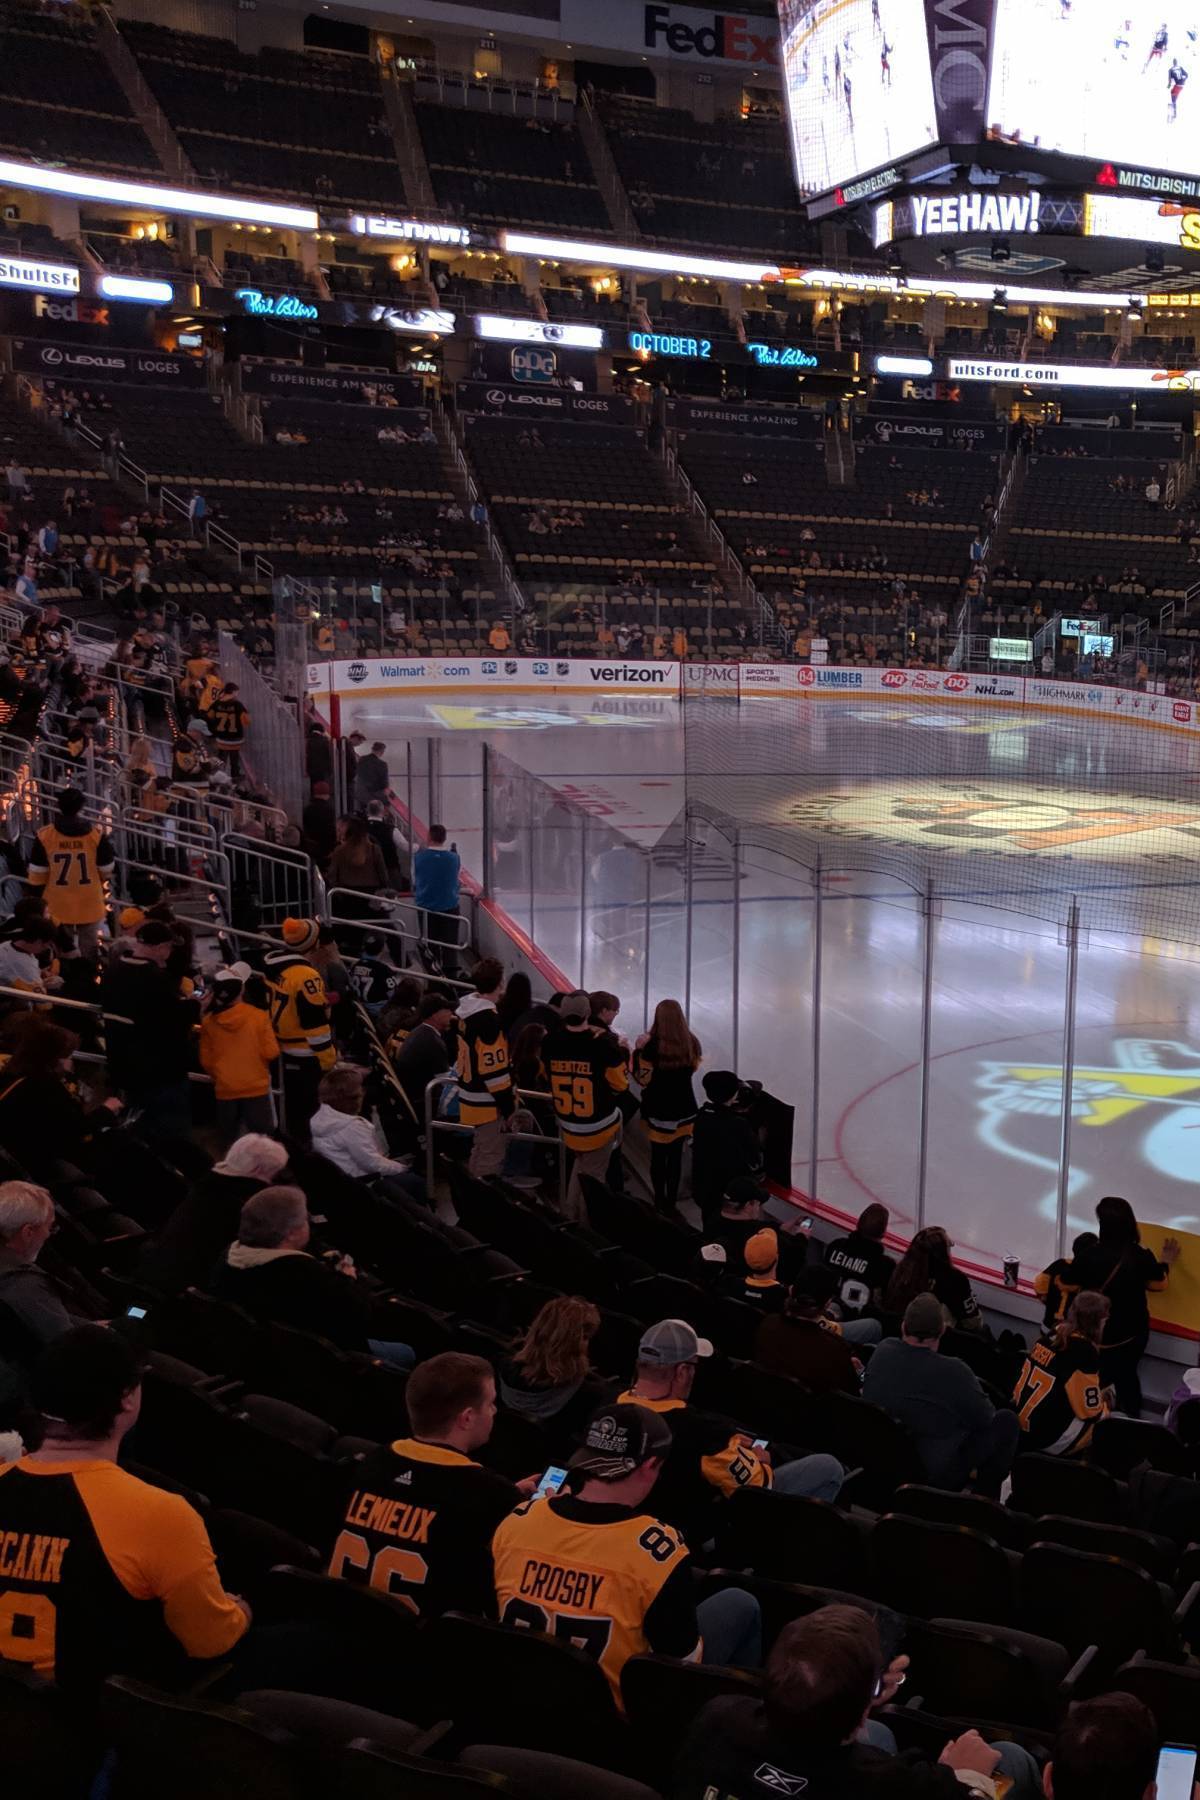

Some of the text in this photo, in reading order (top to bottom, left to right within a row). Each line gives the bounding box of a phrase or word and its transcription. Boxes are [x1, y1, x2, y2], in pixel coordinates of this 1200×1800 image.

[644, 4, 779, 65] FedEx
[870, 168, 897, 191] ELECTRIC
[1119, 170, 1196, 197] MITSUBISHI
[911, 191, 1040, 236] YEEHAW!
[34, 295, 110, 326] FedEx
[238, 289, 318, 319] Phil Collins
[632, 332, 711, 357] OCTOBER 2
[748, 343, 818, 368] Phil Collins
[65, 354, 180, 374] LEXUS LOGES
[954, 363, 1059, 381] ultsFord.com
[270, 373, 395, 393] EXPERIENCE AMAING
[902, 380, 961, 403] FedEx
[508, 393, 609, 412] LEXUS LOGES
[690, 408, 798, 426] EXPERIENCE AMAZING
[894, 425, 985, 439] LEXUS LOGES
[380, 665, 470, 677] Walmart com
[590, 665, 664, 682] verizon
[688, 667, 739, 682] UPMC
[817, 671, 862, 684] LUMBER
[1039, 687, 1086, 702] HIGHMARK
[216, 711, 238, 733] 71
[54, 852, 91, 886] 71
[304, 977, 321, 994] 87
[484, 1048, 505, 1067] 30
[551, 1075, 594, 1118] 59
[829, 1248, 869, 1275] LETANG
[345, 1489, 437, 1545] LEMIEUX
[519, 1558, 604, 1611] CROSBY
